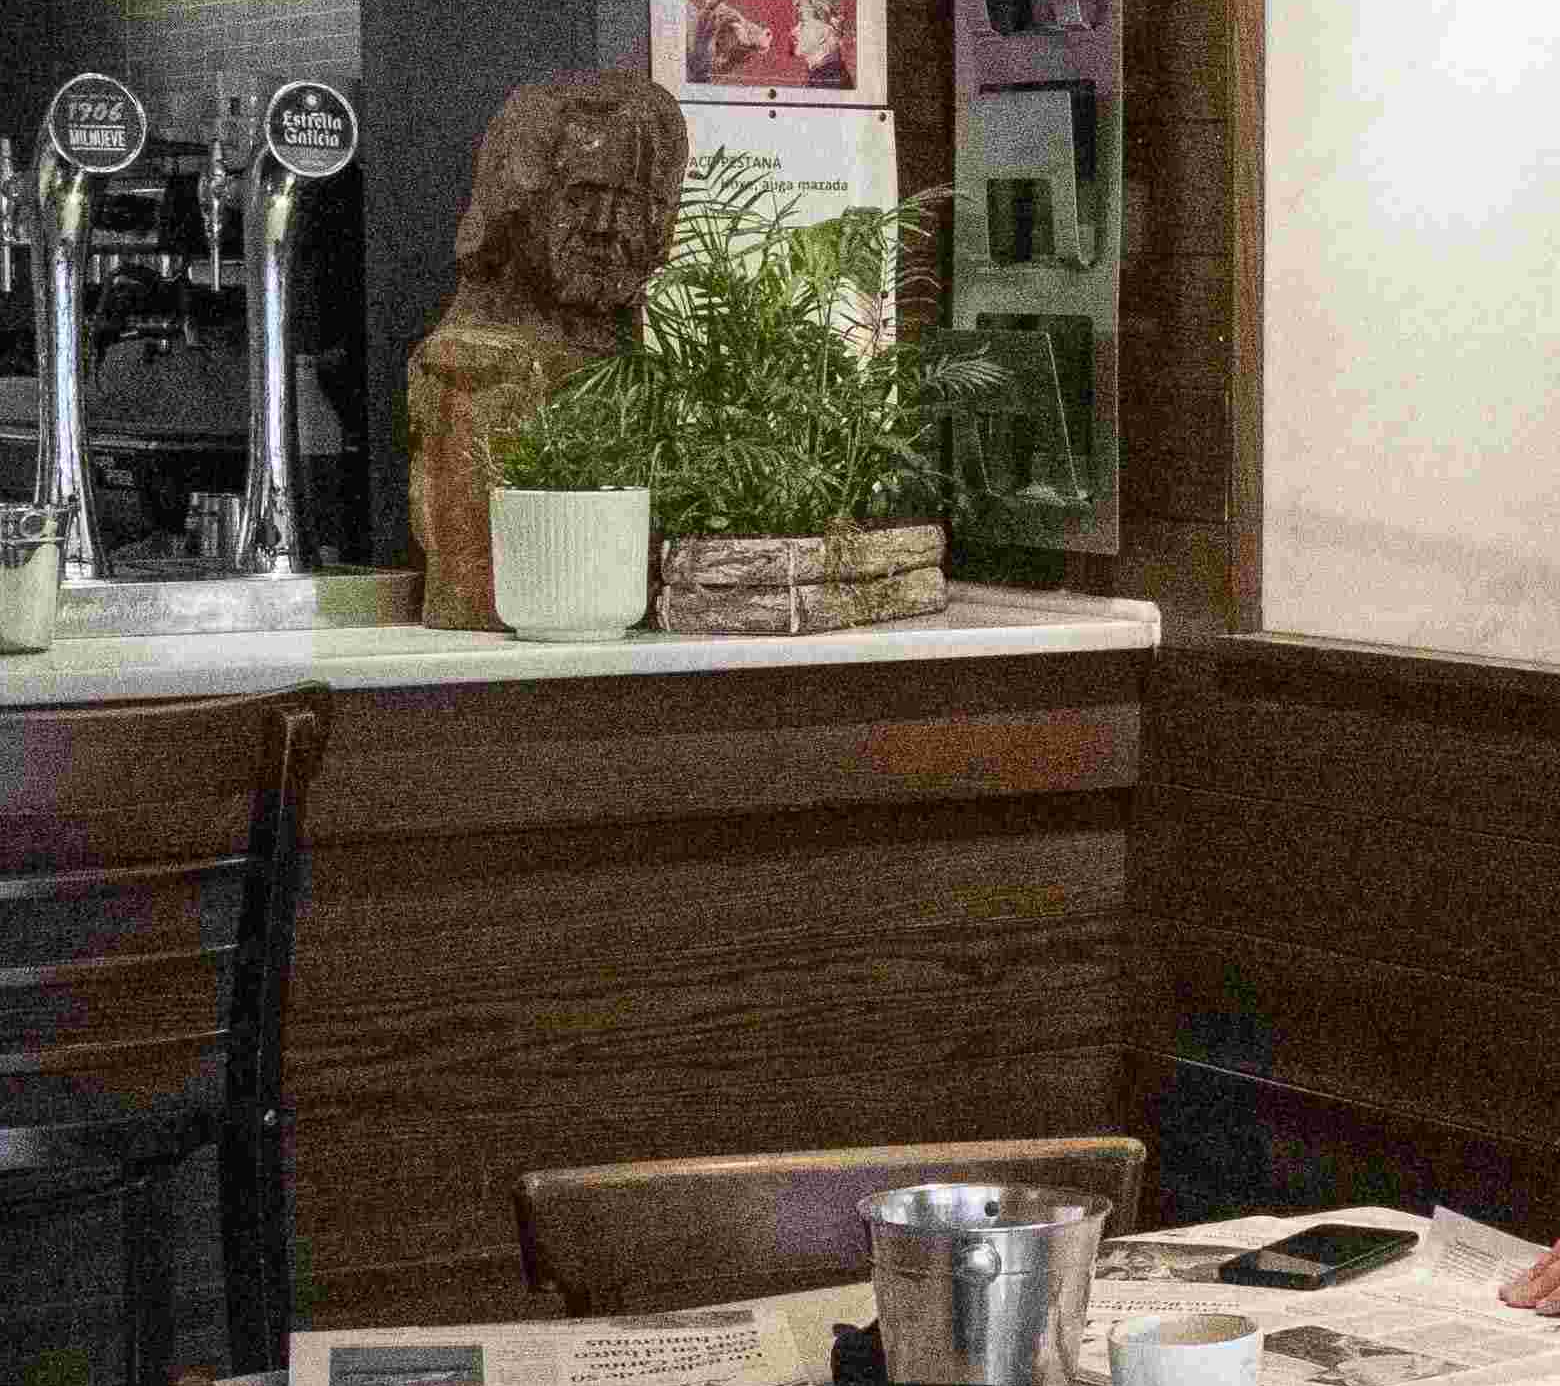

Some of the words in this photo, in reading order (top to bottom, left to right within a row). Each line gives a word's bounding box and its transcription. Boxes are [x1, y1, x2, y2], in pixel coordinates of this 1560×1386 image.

[68, 101, 124, 123] 1906
[282, 110, 343, 130] Estrella
[284, 127, 340, 147] Galicia
